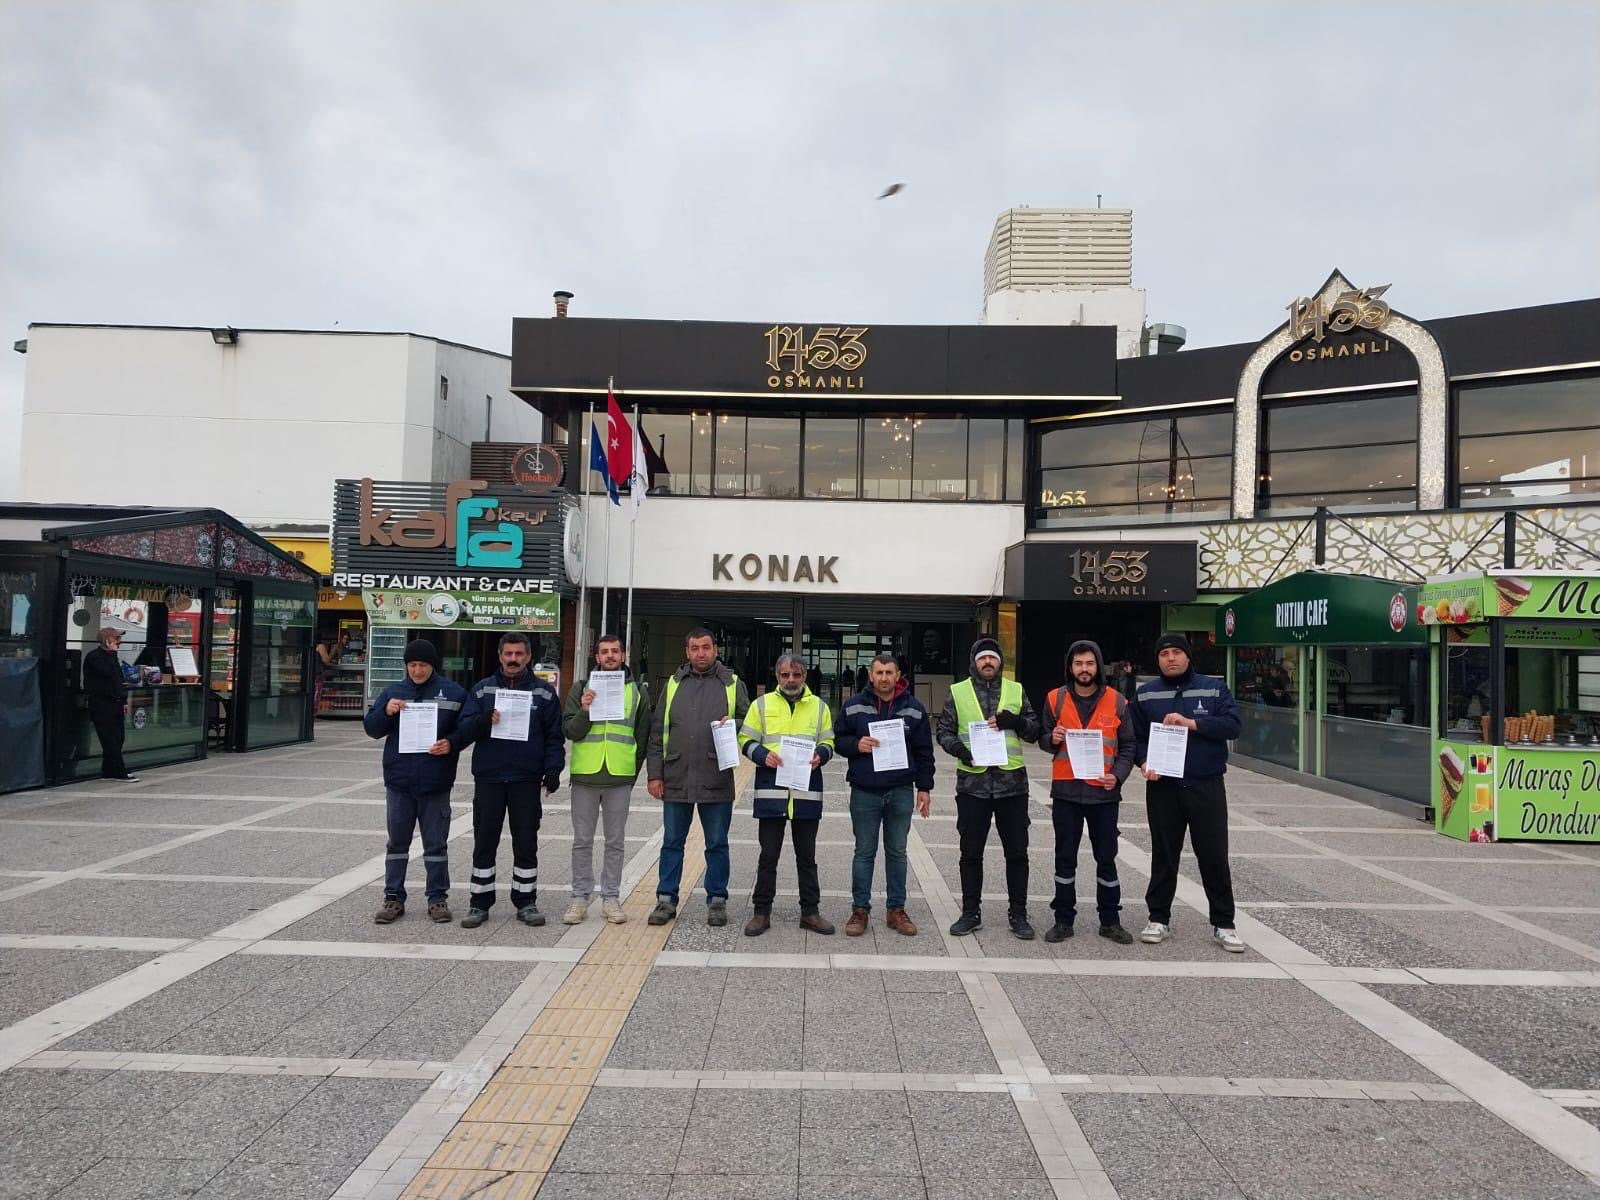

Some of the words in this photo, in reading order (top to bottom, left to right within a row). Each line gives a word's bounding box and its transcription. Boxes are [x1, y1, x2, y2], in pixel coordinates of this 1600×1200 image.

[1286, 283, 1392, 343] 1453
[765, 324, 869, 377] 1453
[1290, 340, 1390, 361] OSMANLI
[767, 376, 864, 388] OSMANLI
[1041, 489, 1088, 506] 1453
[713, 553, 839, 583] KONAK
[1069, 548, 1150, 588] 1453
[333, 573, 474, 591] RESTAURANT
[479, 577, 495, 591] &
[496, 578, 554, 593] CAFE
[1074, 586, 1146, 596] OSMANLI
[468, 604, 499, 615] KAFFA
[1276, 601, 1304, 628] RIHTIM
[1306, 599, 1328, 626] CAFE
[1499, 758, 1573, 800] Maraş
[1581, 760, 1600, 791] D
